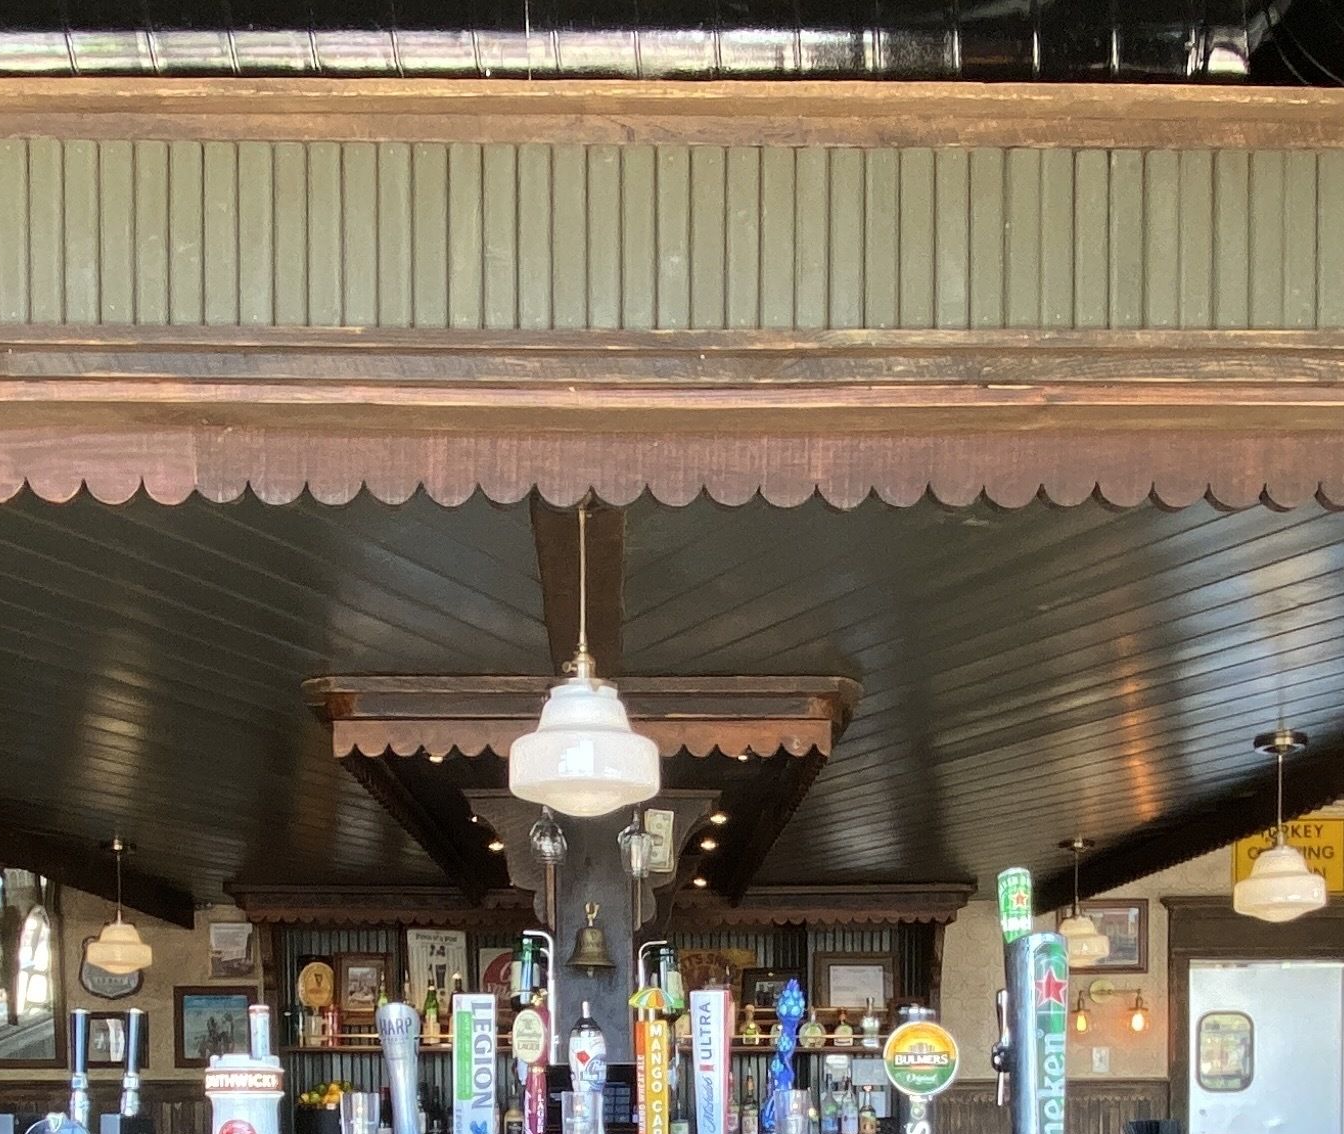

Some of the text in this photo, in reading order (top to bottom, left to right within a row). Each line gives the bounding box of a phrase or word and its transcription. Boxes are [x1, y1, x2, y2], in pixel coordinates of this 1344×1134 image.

[379, 1017, 412, 1036] HARP
[699, 1002, 713, 1060] ULTRA
[471, 1002, 493, 1110] LEGION
[648, 1023, 663, 1093] MANGO
[894, 1053, 949, 1066] BULMERS
